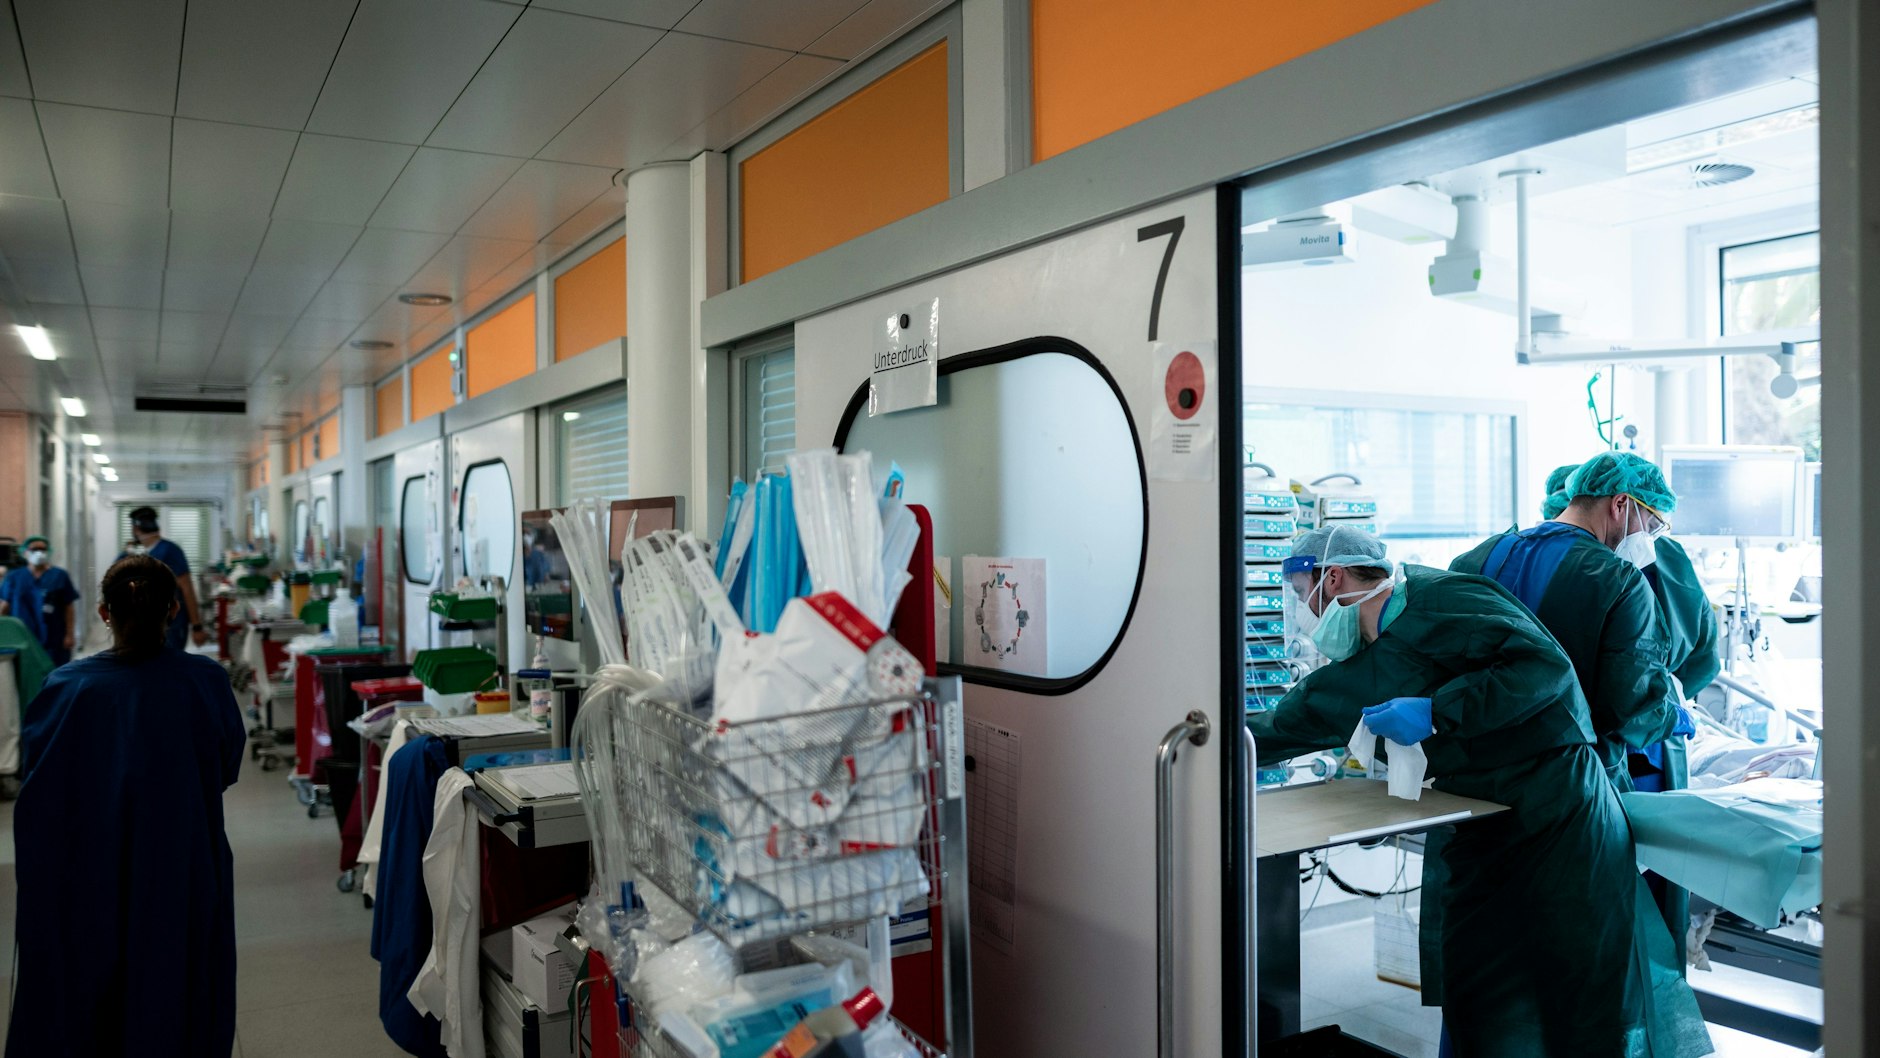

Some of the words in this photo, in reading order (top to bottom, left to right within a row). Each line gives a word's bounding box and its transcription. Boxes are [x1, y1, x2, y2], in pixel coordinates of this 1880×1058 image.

[1300, 235, 1330, 245] Movita
[1137, 215, 1185, 342] 7
[874, 339, 928, 369] Unterdruck
